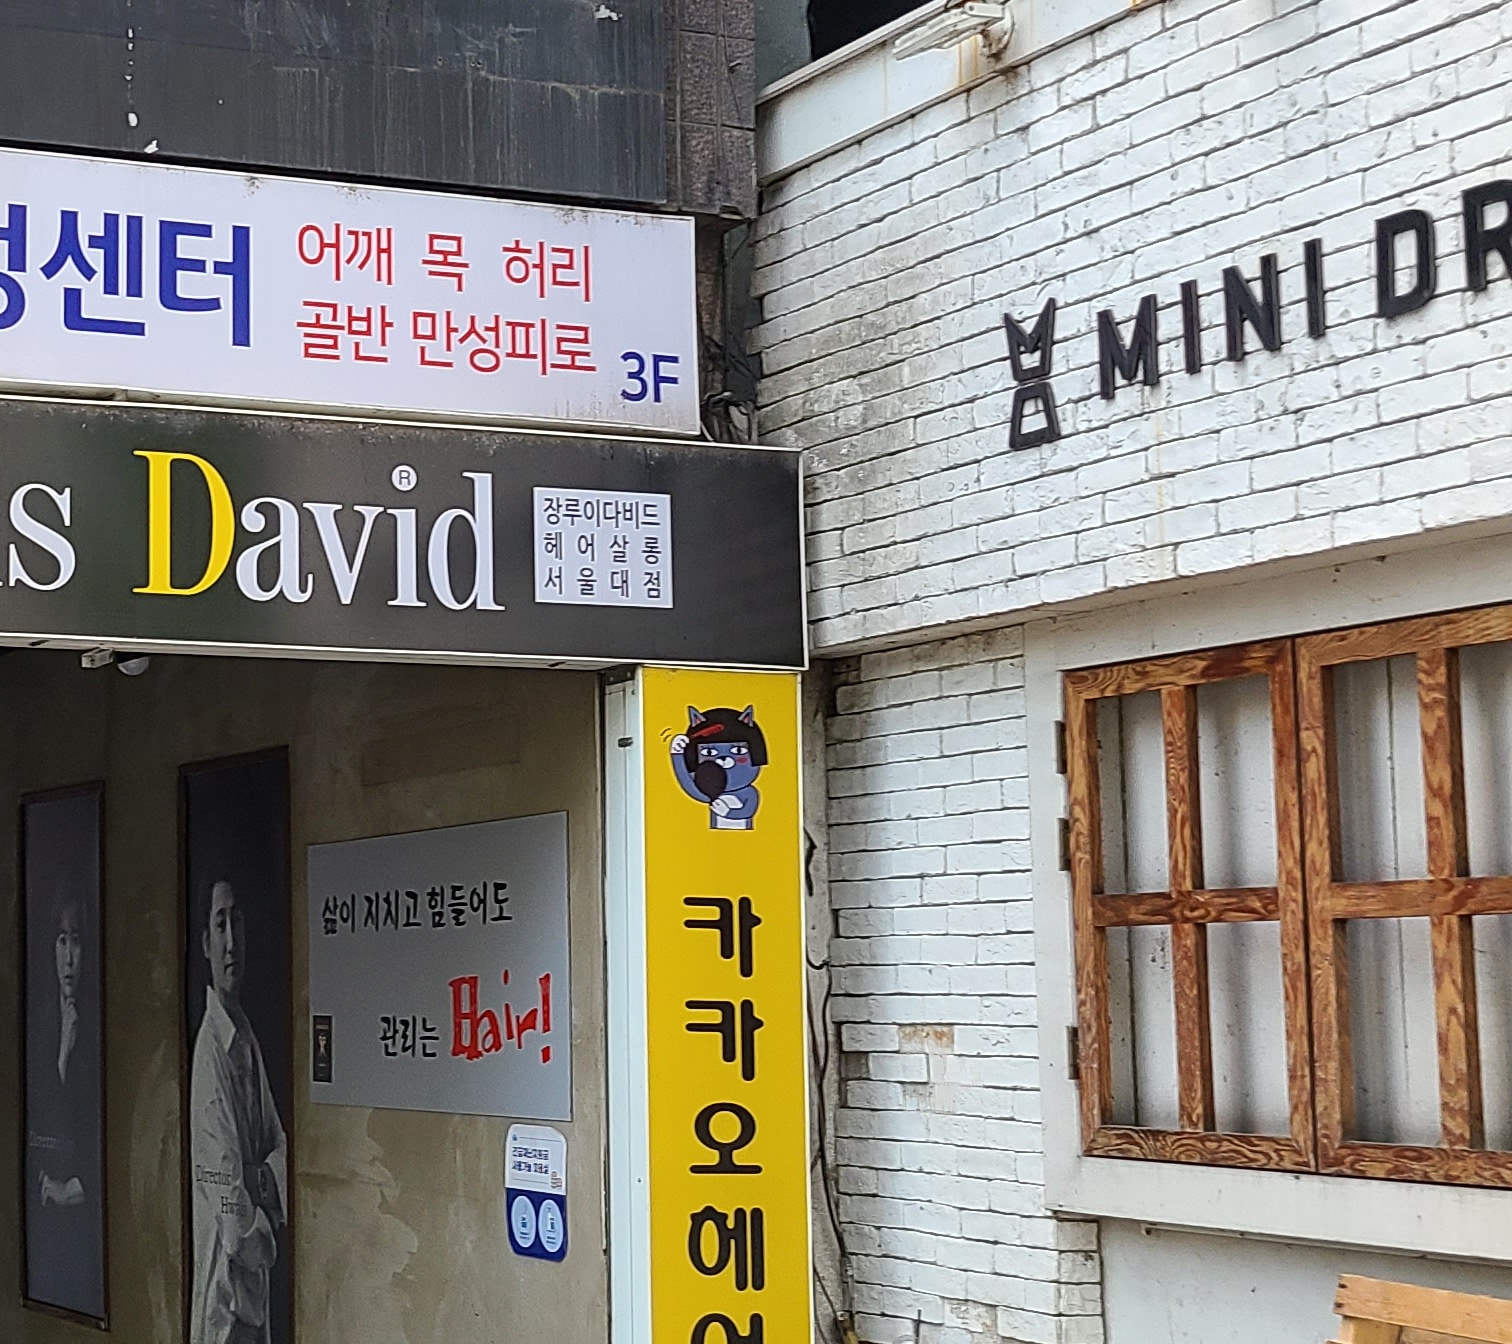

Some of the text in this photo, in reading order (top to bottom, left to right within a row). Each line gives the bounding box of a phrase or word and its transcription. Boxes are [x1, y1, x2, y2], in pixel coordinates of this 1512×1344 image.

[297, 223, 591, 303] 어깨 목 허리
[296, 300, 597, 377] 골반 만성피로
[1097, 236, 1328, 401] MINI
[619, 350, 681, 404] 3F
[131, 448, 506, 613] David
[543, 496, 662, 531] 장루이다비드
[322, 881, 513, 935] 삶이 지치고 힘들어도
[380, 1014, 439, 1058] 관리는
